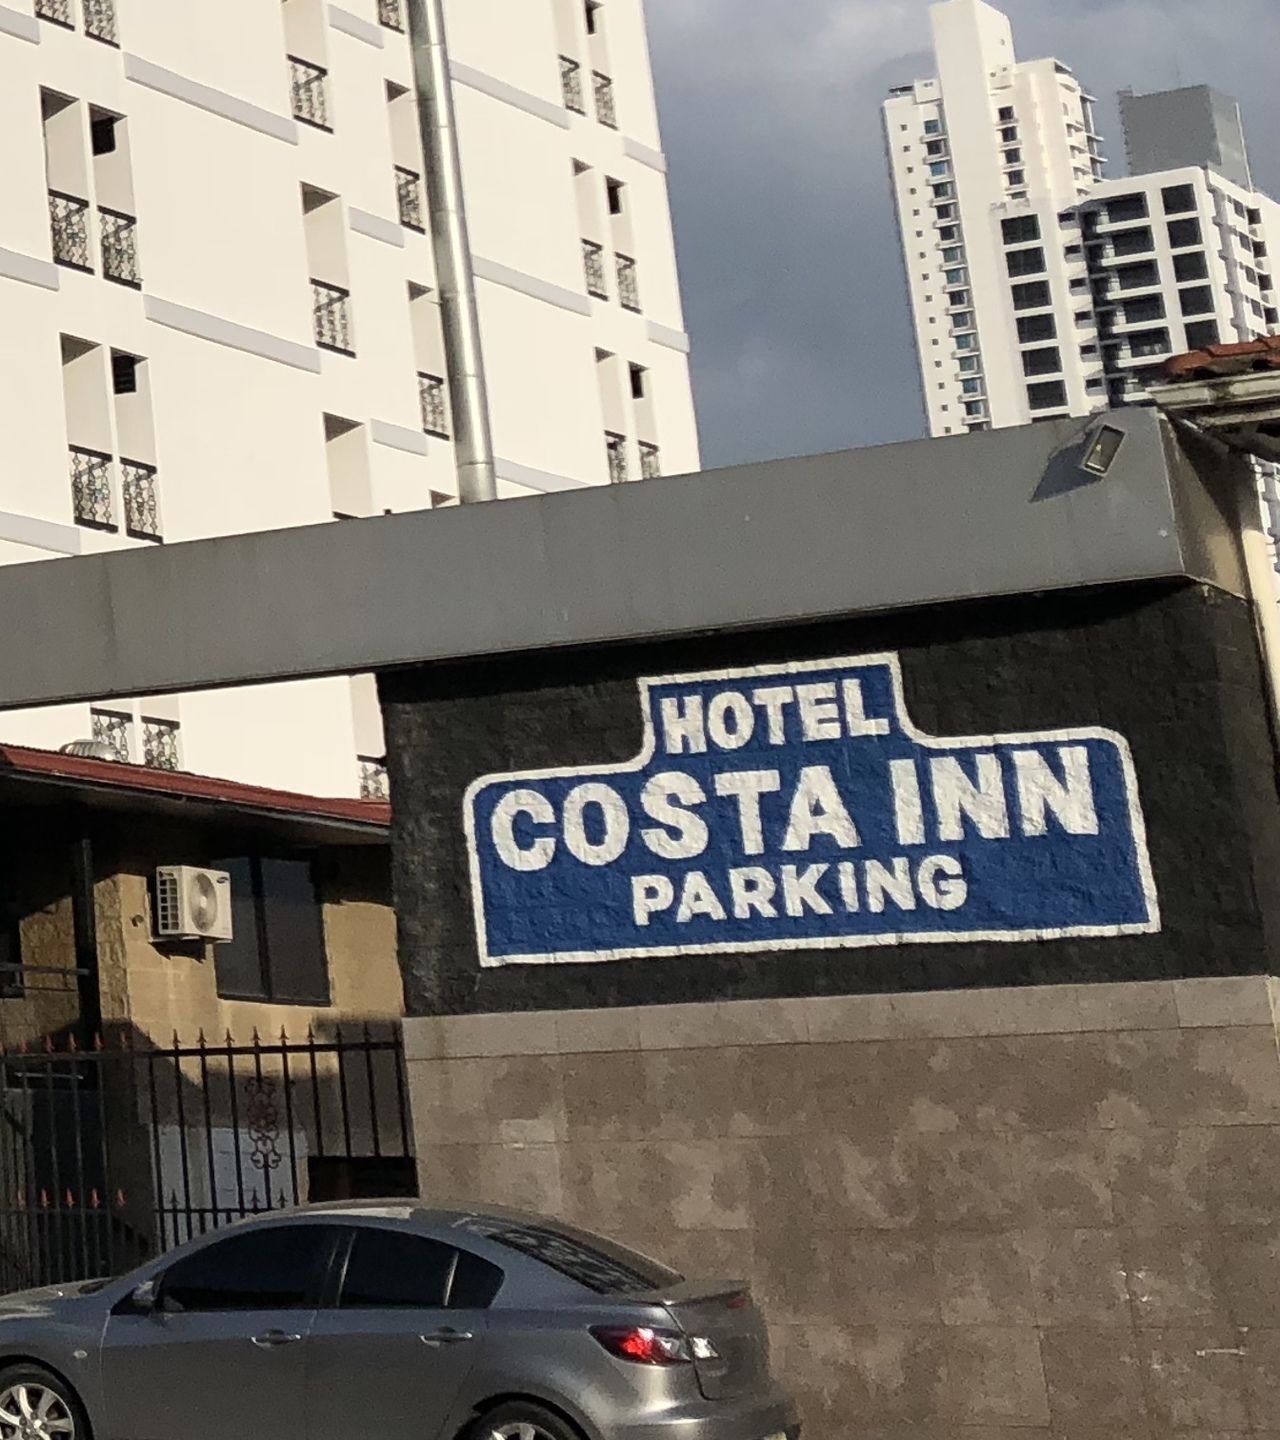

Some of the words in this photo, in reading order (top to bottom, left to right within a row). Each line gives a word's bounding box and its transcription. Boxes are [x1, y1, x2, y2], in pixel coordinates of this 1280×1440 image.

[661, 678, 890, 754] HOTEL
[492, 764, 861, 871] COSTA
[891, 746, 1099, 845] INN
[631, 854, 967, 926] PARKING
